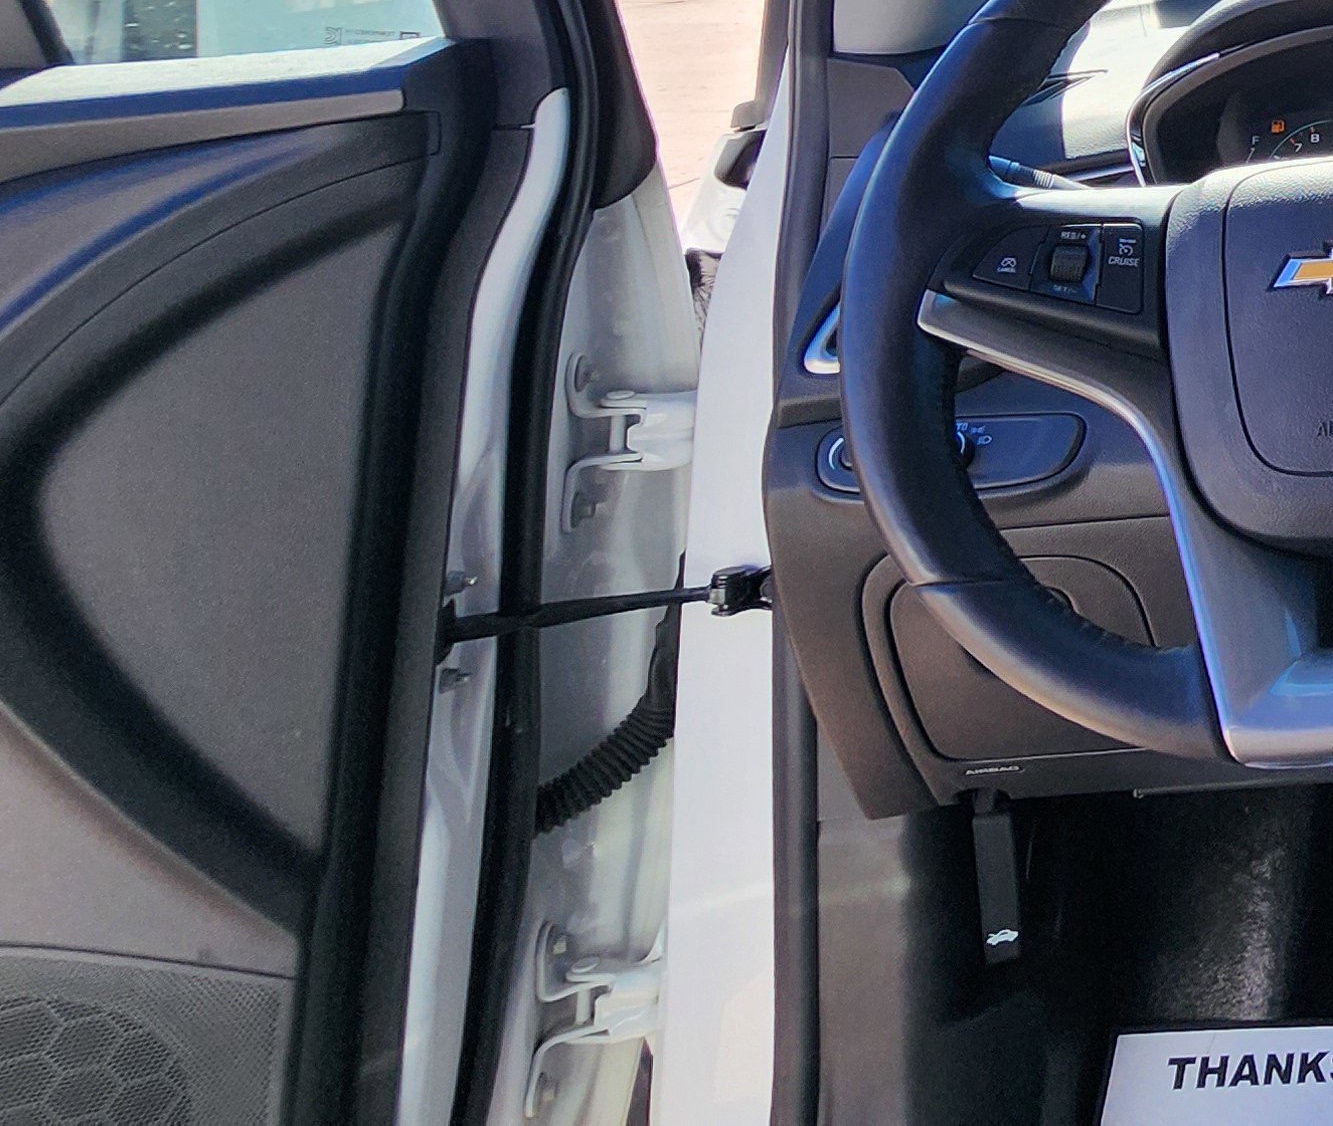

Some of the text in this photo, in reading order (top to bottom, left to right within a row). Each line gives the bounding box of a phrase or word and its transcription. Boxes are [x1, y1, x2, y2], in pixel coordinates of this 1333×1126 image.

[1252, 136, 1260, 145] F
[1295, 143, 1302, 152] 7
[1108, 256, 1140, 267] CRUISE
